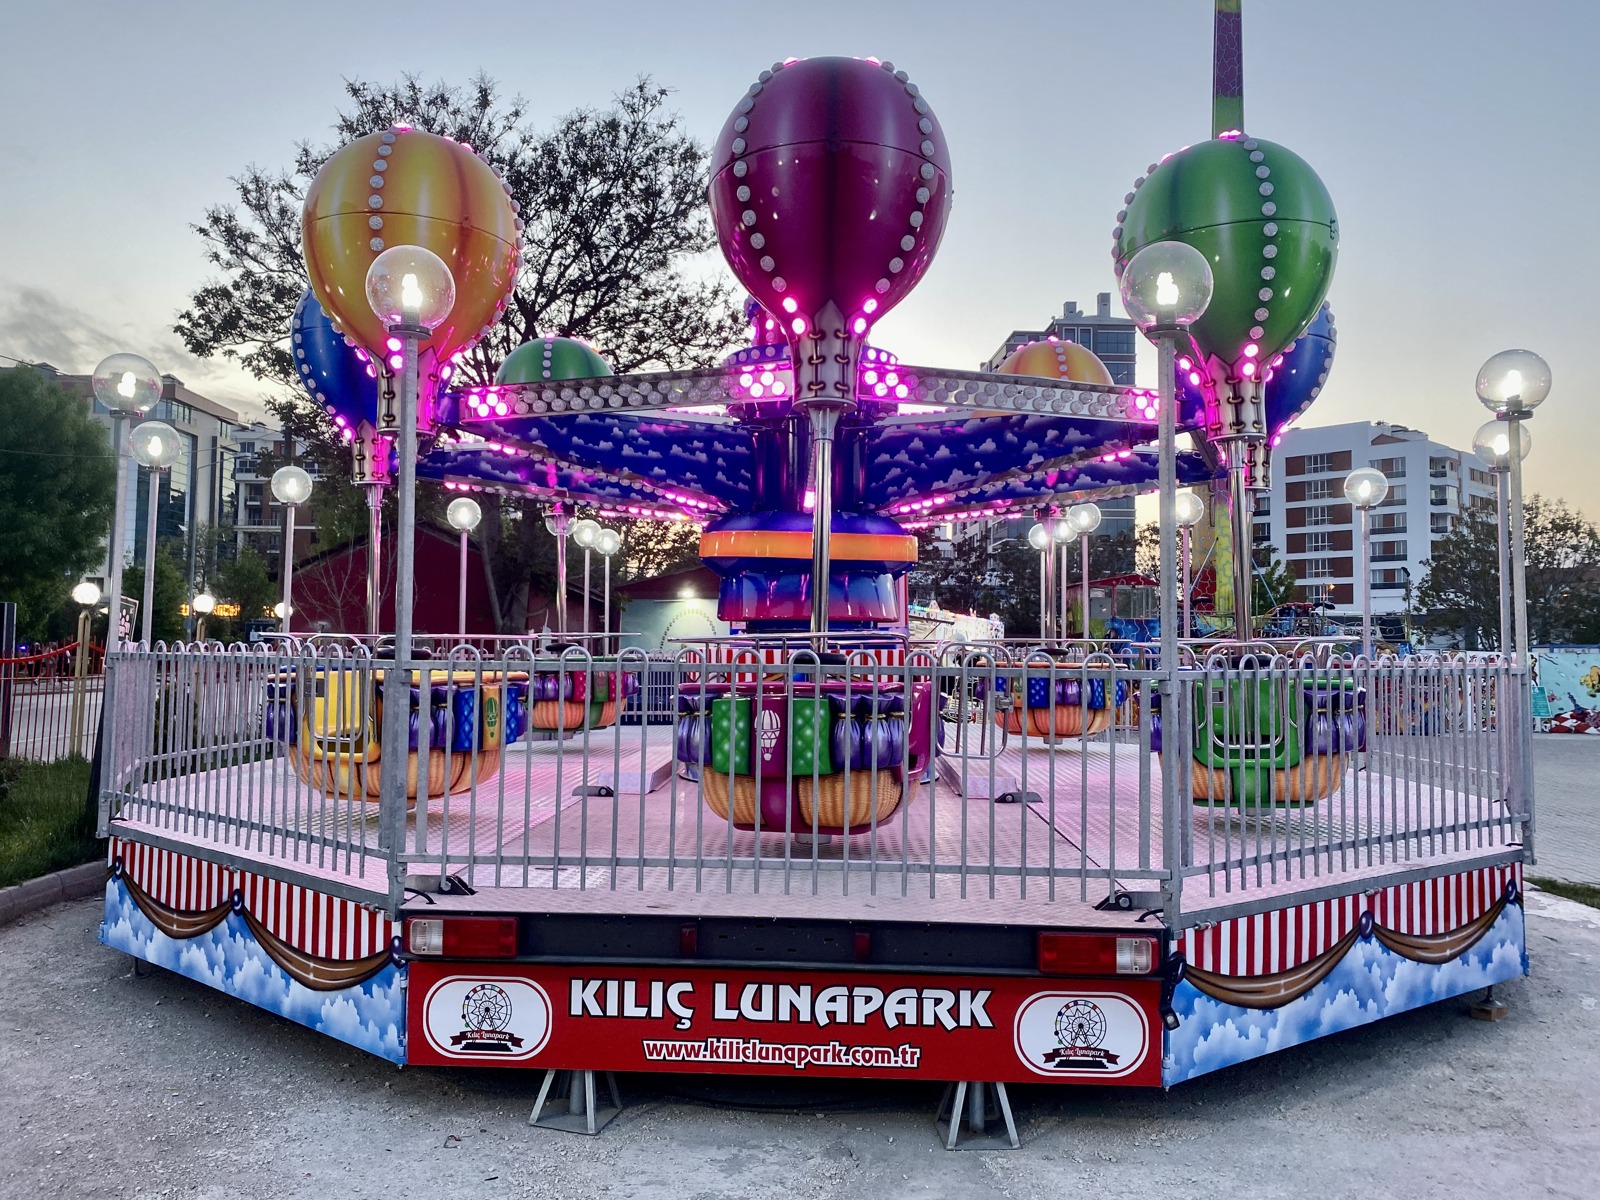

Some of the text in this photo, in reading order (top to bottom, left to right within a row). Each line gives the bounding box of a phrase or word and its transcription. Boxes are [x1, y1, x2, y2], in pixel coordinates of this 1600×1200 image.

[569, 978, 994, 1031] KILIÇ LUNAPARK
[643, 1038, 920, 1068] www.kiliclunapark.com.tr
